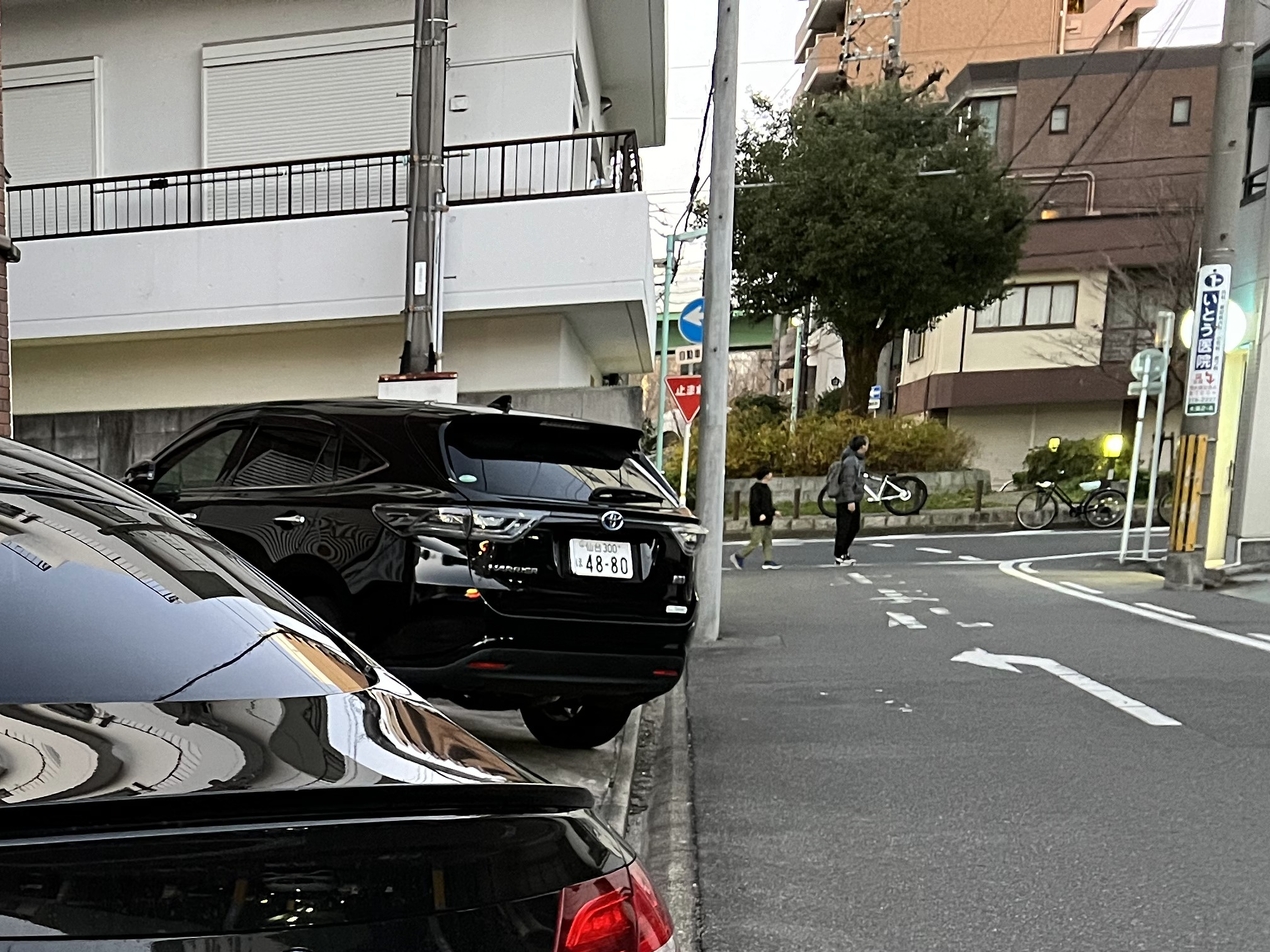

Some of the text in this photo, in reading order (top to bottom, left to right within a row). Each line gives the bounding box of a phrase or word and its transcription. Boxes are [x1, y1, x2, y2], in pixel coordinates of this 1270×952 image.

[1196, 293, 1218, 369] いとう医院
[586, 554, 628, 575] 48-80
